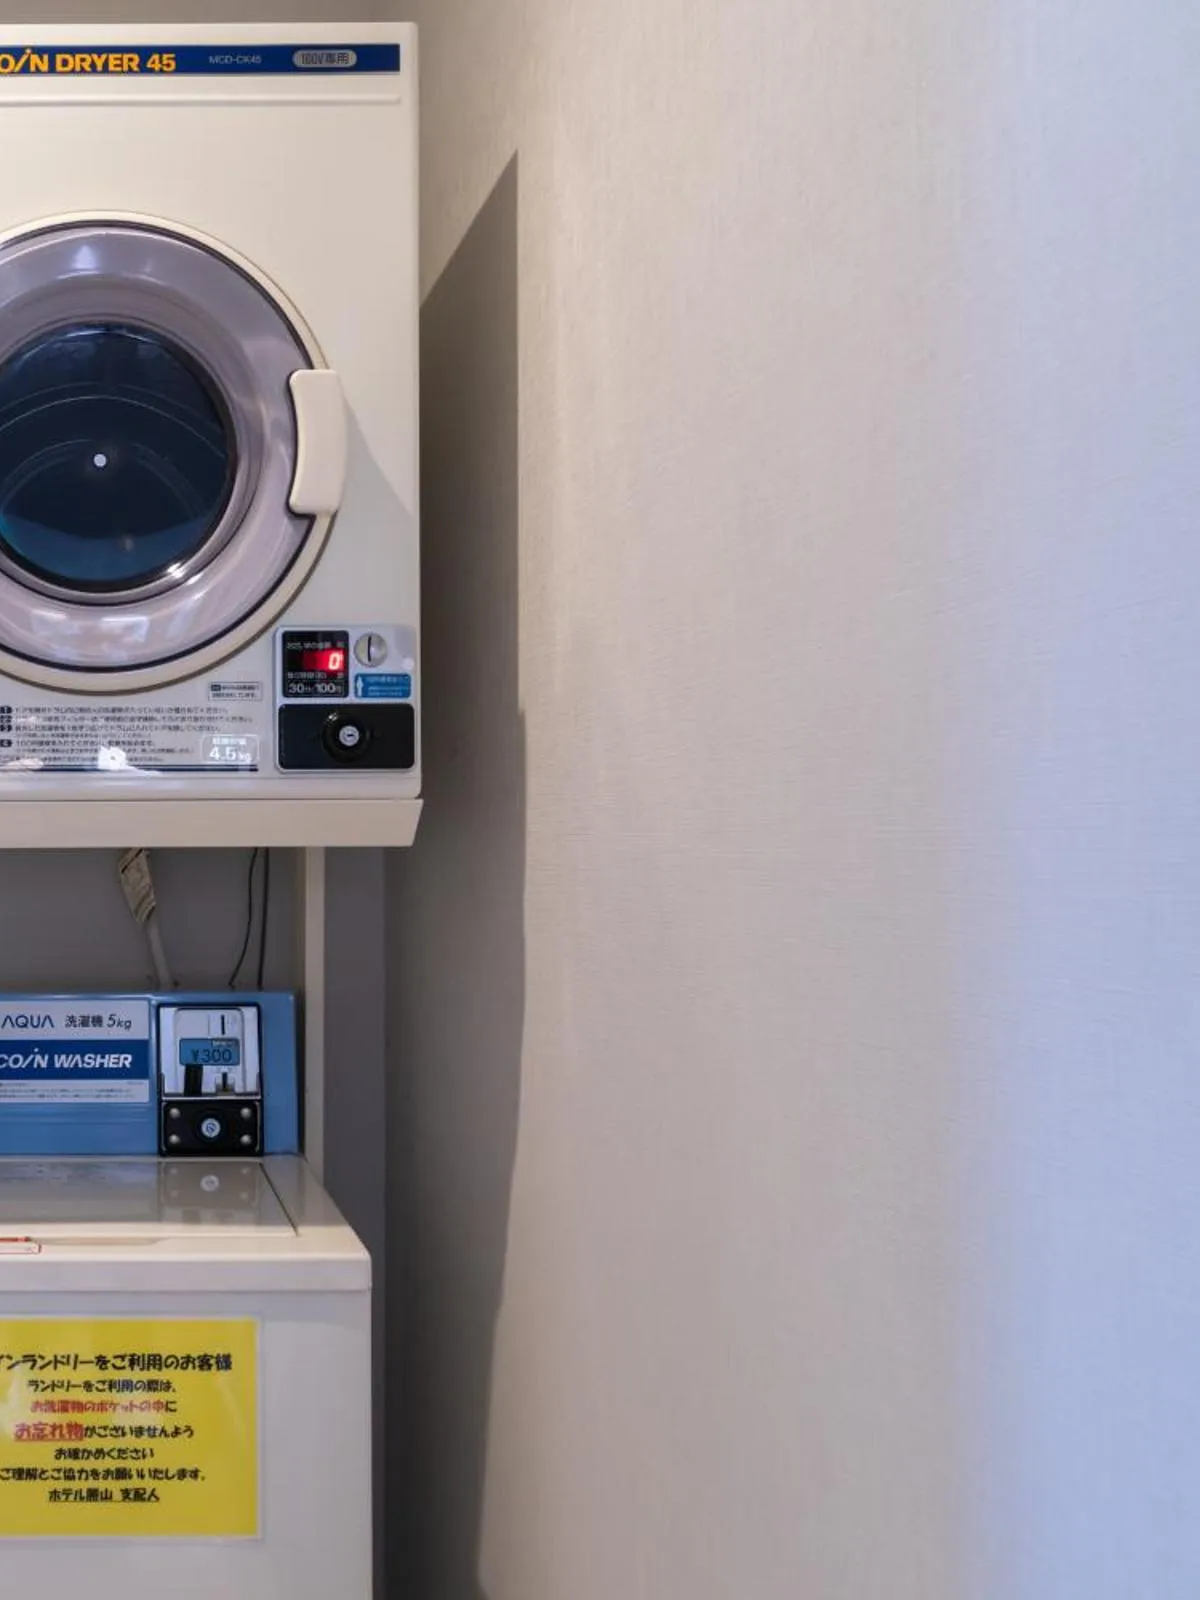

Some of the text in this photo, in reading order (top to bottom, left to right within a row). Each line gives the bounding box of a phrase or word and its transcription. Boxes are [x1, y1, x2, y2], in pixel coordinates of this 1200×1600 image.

[55, 53, 140, 73] DRYER
[146, 53, 176, 72] 45
[328, 652, 341, 670] 0
[1, 1014, 55, 1029] AQUA
[65, 1013, 132, 1030] 洗濯機 5kg
[54, 1054, 132, 1068] WASHER
[31, 1399, 178, 1413] お洗濯物のポケットの中に
[14, 1421, 195, 1441] お忘れ物がございませんよう
[54, 1447, 155, 1461] お確かめください
[0, 1467, 206, 1482] ご理解とご協力をお願いいたします。
[120, 1487, 160, 1502] 支配人
